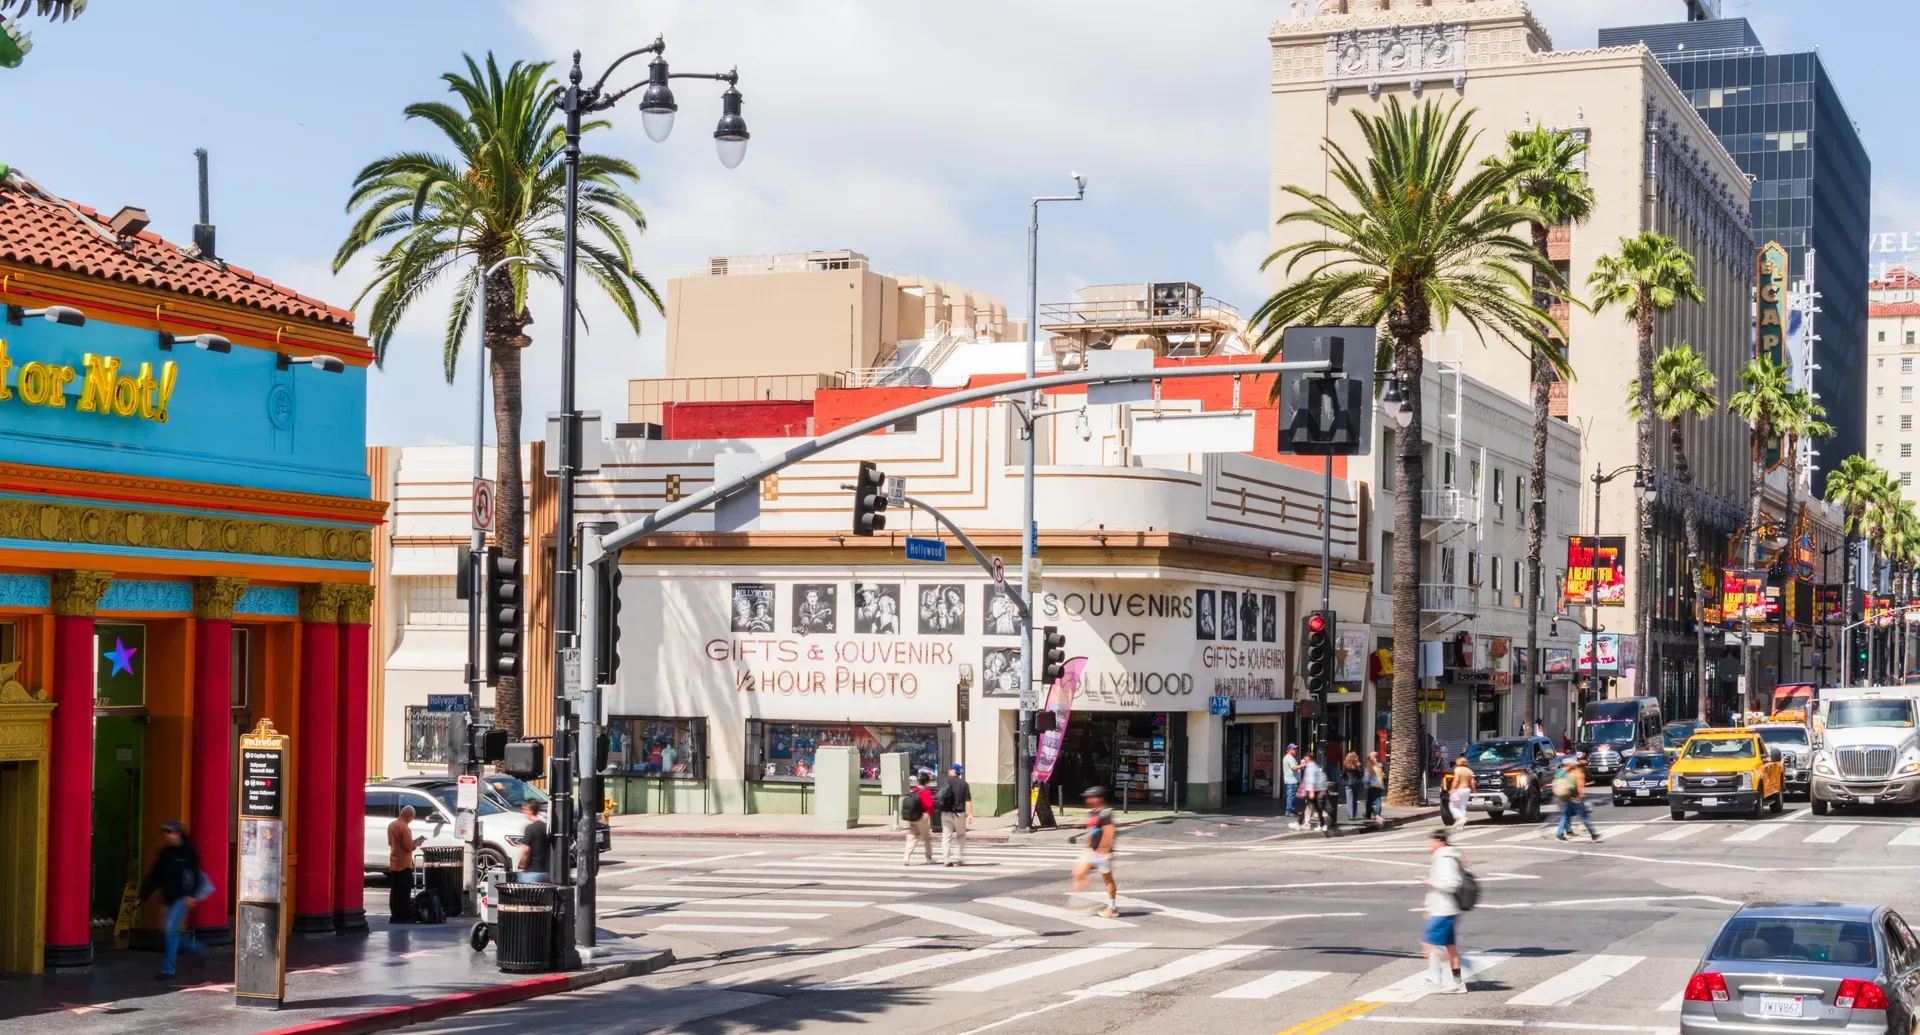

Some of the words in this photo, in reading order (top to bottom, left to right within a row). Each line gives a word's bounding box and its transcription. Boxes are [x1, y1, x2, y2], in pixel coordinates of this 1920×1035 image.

[18, 361, 75, 408] or
[77, 353, 178, 423] Not!
[910, 543, 942, 558] Hollywood
[1568, 567, 1574, 581] A
[735, 590, 773, 598] HOLLYWOOD
[1567, 581, 1588, 594] NOISE
[1043, 592, 1194, 619] SOUVENIRS
[1109, 632, 1146, 655] OF
[565, 651, 580, 662] LAPD
[705, 639, 799, 663] GIFTS
[807, 644, 825, 661] &
[834, 640, 953, 665] SOUVENIRS
[1203, 645, 1238, 669] GIFTS
[1239, 651, 1246, 667] &
[1247, 648, 1285, 670] SOUVENIRS
[1580, 656, 1600, 665] BOA
[1601, 656, 1616, 664] TEA
[762, 669, 826, 696] HOUR
[835, 666, 919, 697] PHOTO
[1060, 671, 1195, 696] OLLYWOOD
[1223, 677, 1247, 699] HOUR
[430, 695, 457, 707] Hollywood
[1021, 701, 1028, 709] OK
[1211, 698, 1229, 707] ATM
[244, 739, 280, 747] HOLLYWOOD
